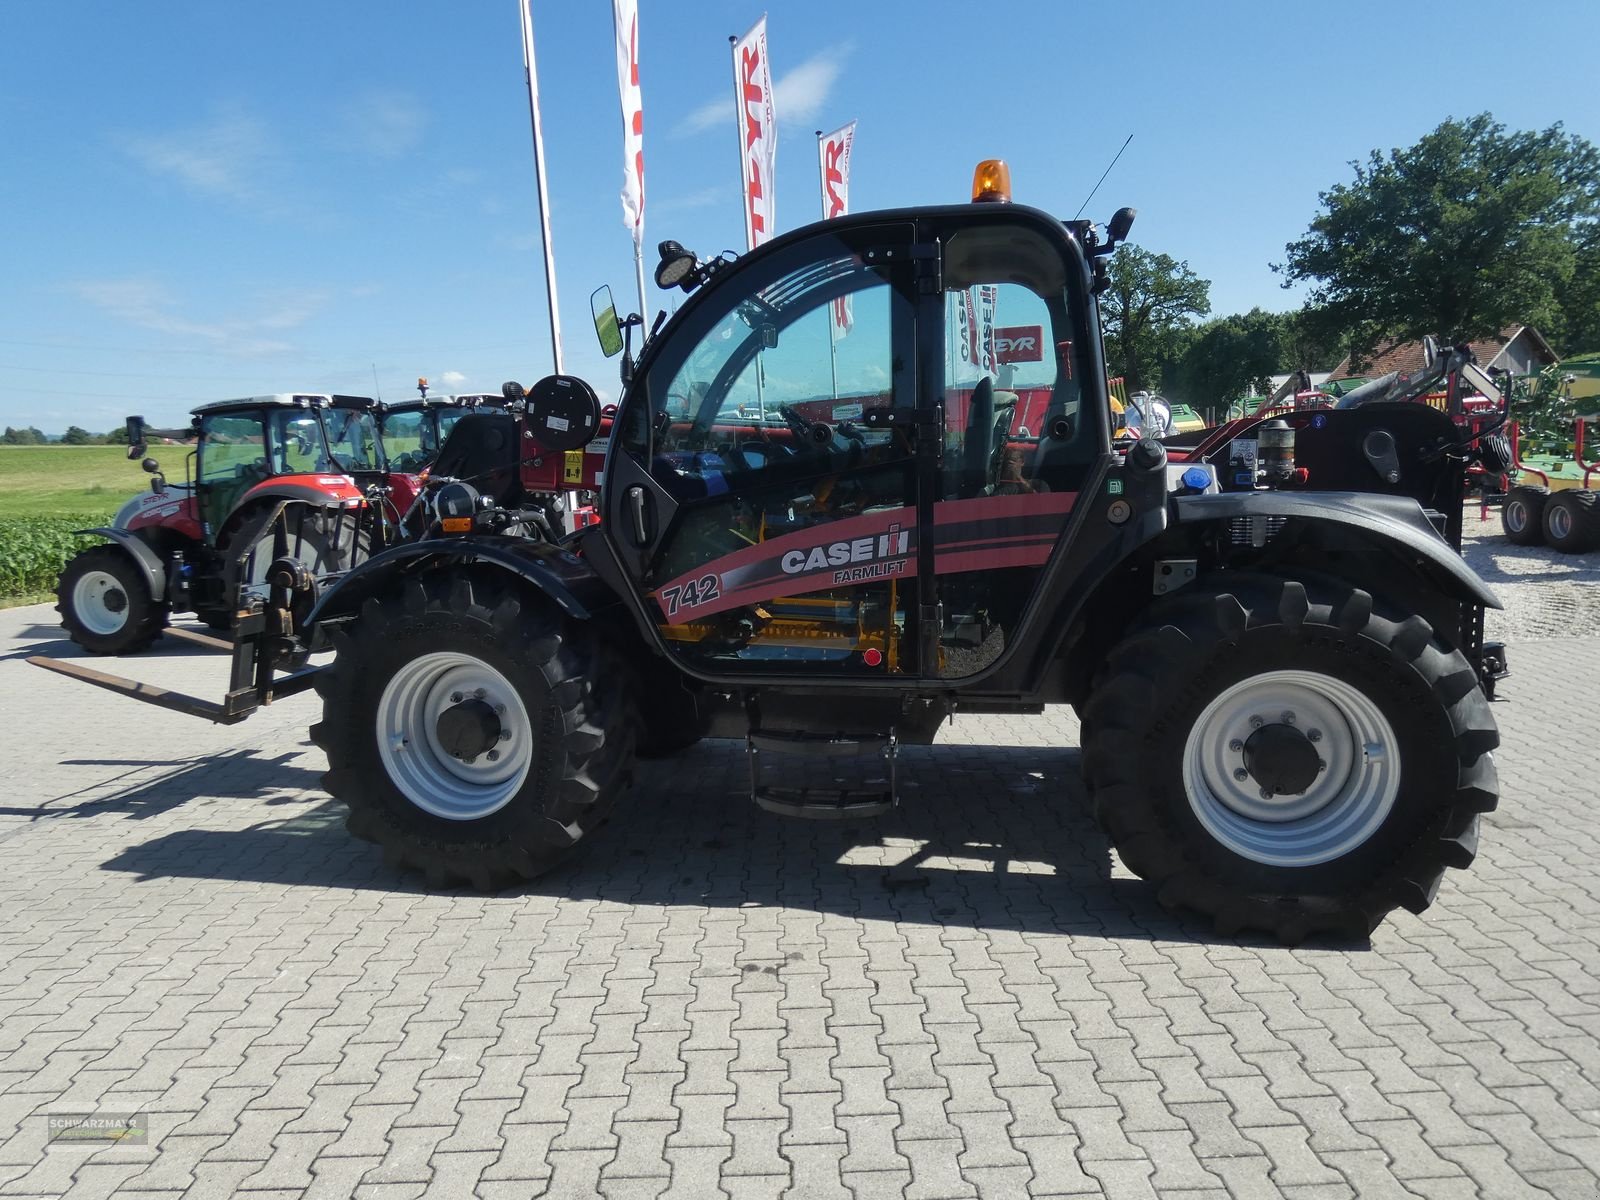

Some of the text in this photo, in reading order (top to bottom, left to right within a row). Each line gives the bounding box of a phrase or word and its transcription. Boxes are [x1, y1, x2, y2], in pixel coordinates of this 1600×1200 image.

[983, 308, 992, 371] CASE
[995, 337, 1035, 353] EYR
[781, 536, 873, 574] CASE
[833, 559, 906, 585] FARMLIFT
[662, 573, 720, 616] 742
